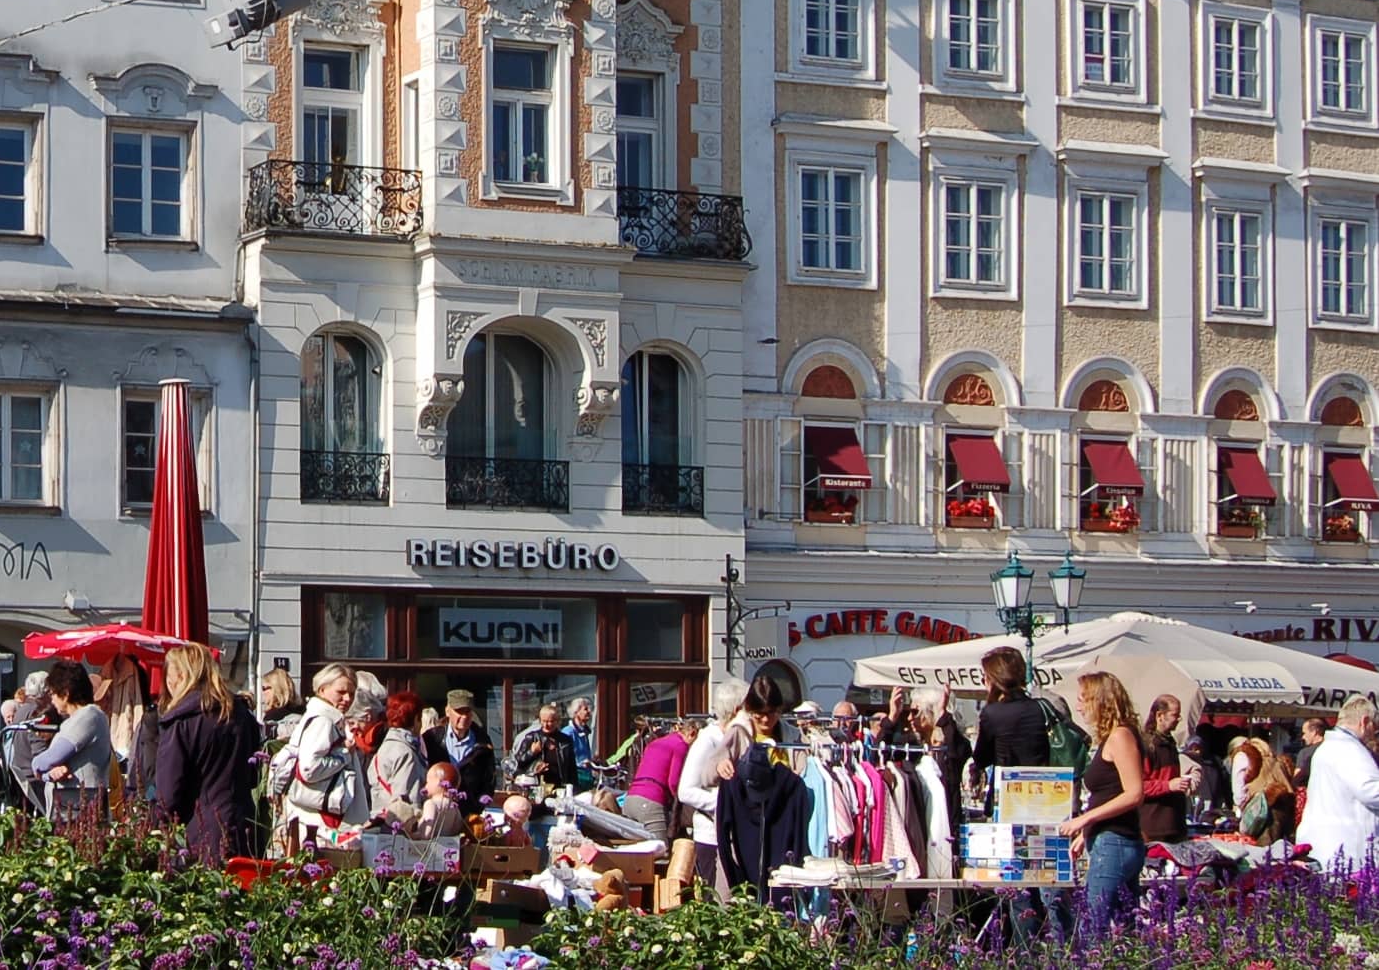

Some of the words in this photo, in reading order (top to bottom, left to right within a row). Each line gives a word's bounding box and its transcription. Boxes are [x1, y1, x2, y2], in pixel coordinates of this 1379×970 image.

[407, 537, 620, 571] REISEBÜRO
[443, 622, 559, 644] KUONI
[895, 611, 984, 644] GARD
[1312, 618, 1379, 641] RIV
[745, 646, 776, 659] KUONI
[898, 667, 927, 685] EIS
